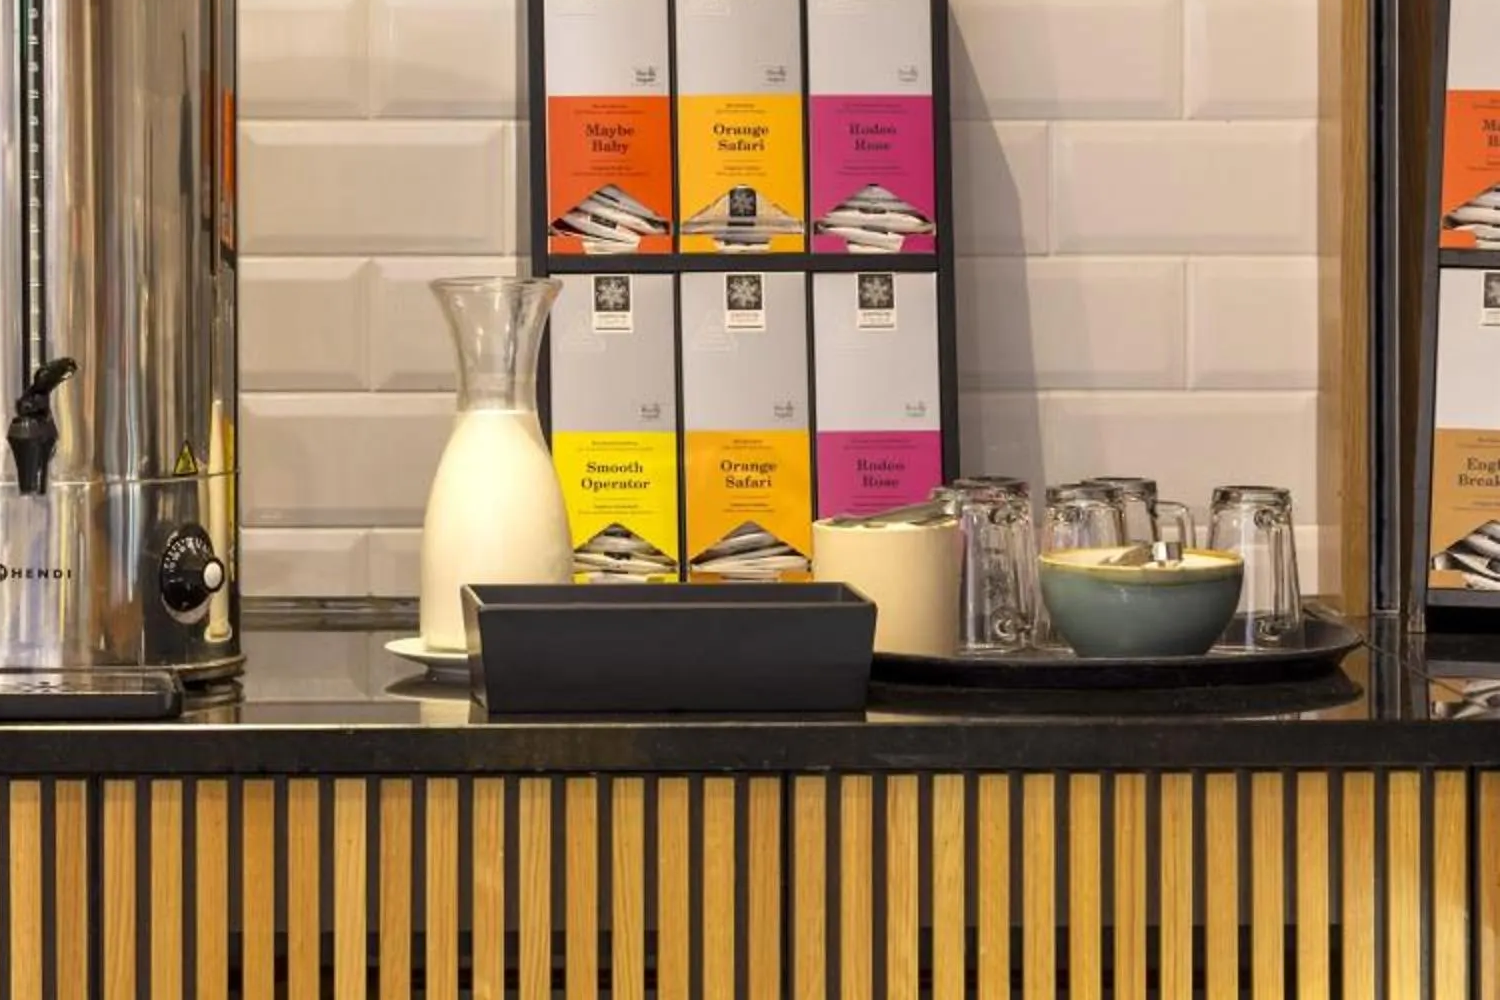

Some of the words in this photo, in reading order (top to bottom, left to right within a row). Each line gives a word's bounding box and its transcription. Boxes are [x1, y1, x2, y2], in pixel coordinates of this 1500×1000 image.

[585, 124, 635, 138] Maybe
[712, 124, 770, 138] Orange
[591, 140, 629, 154] Baby
[717, 139, 766, 151] Safari
[586, 461, 644, 474] Smooth
[720, 460, 777, 474] Orange
[580, 478, 651, 493] Operator
[725, 476, 773, 489] Safari
[11, 568, 71, 579] HENDI
